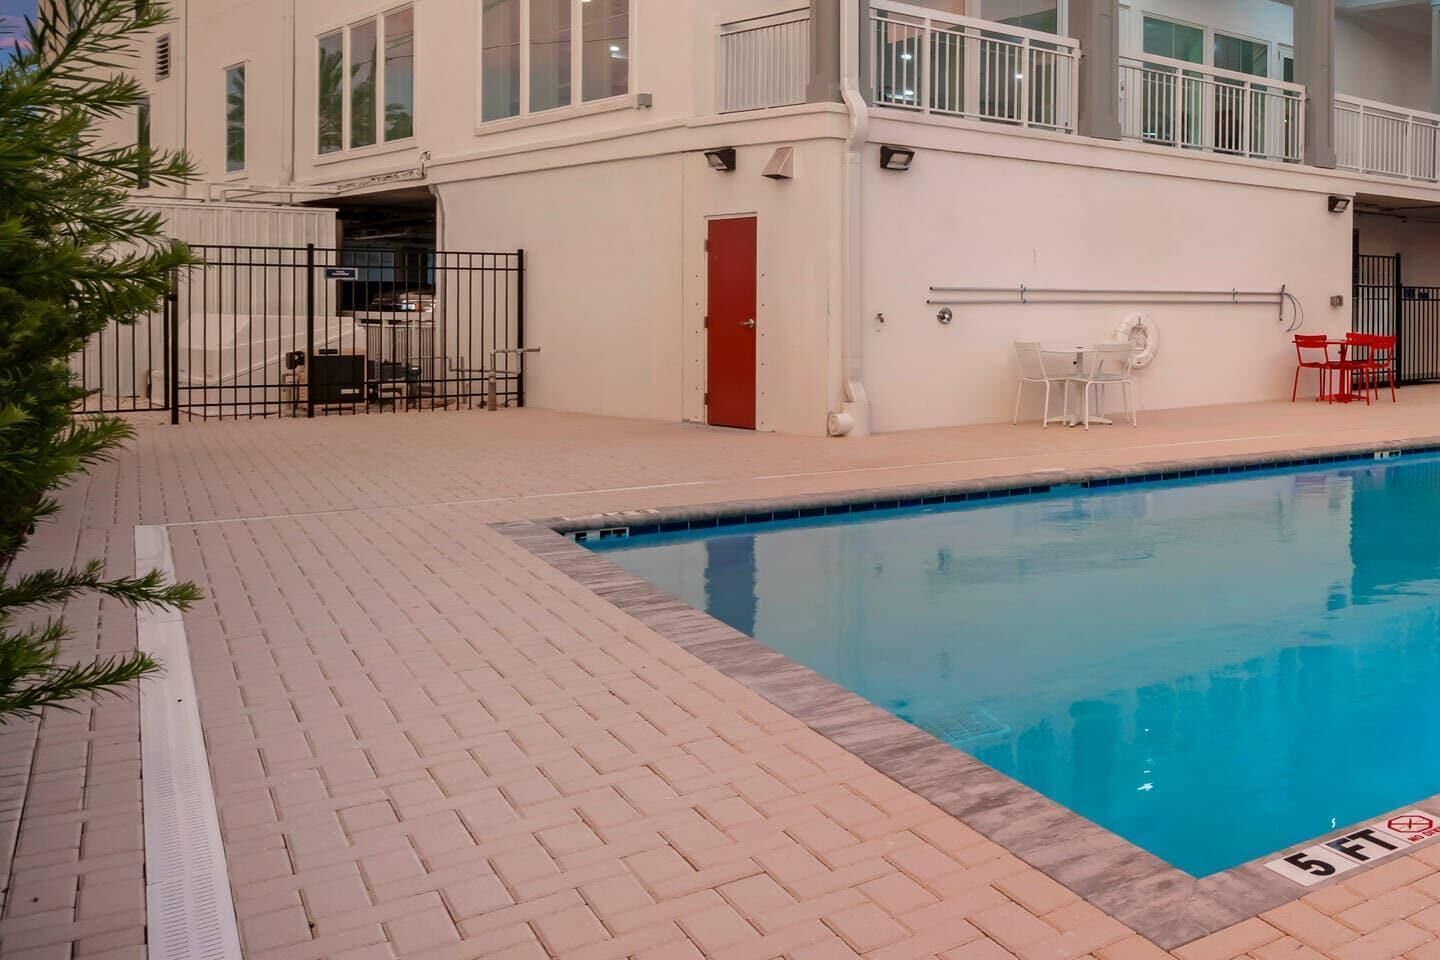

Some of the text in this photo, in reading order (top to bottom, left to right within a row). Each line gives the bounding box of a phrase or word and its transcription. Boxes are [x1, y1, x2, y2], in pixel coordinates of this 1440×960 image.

[1283, 827, 1399, 877] 5 FT
[1408, 834, 1424, 842] NO
